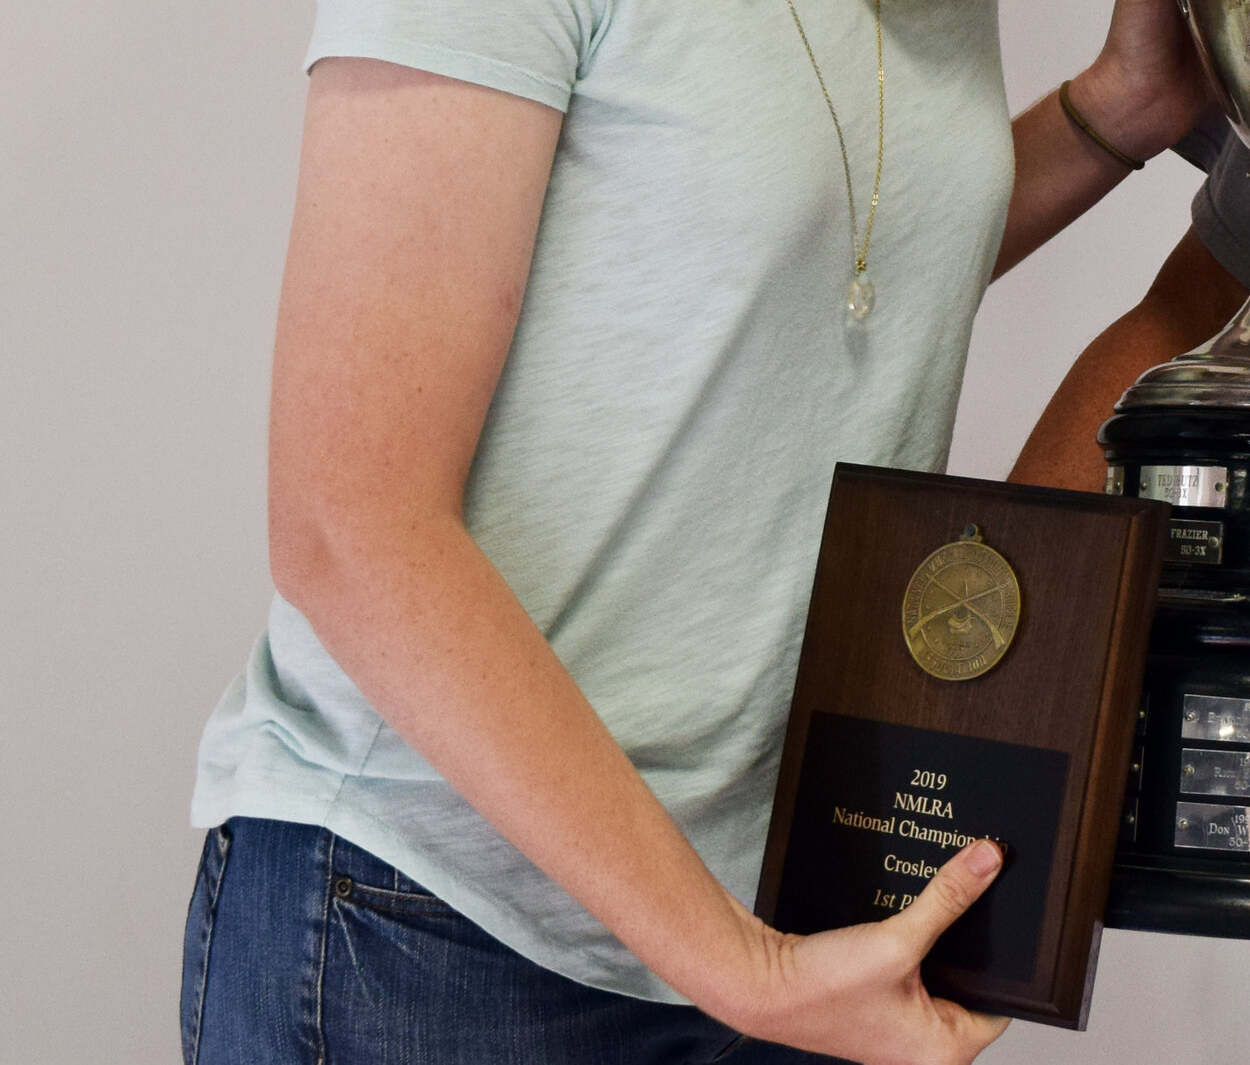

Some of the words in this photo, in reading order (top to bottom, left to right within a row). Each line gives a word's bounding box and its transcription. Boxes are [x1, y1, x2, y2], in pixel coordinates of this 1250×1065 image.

[1170, 528, 1209, 540] FRAZIER
[1181, 544, 1207, 556] 50-3X
[910, 769, 947, 790] 2019
[893, 792, 954, 819] NMLRA
[832, 806, 896, 834] National
[899, 819, 1009, 856] Championp
[1208, 821, 1231, 835] DON
[873, 889, 896, 908] 1st
